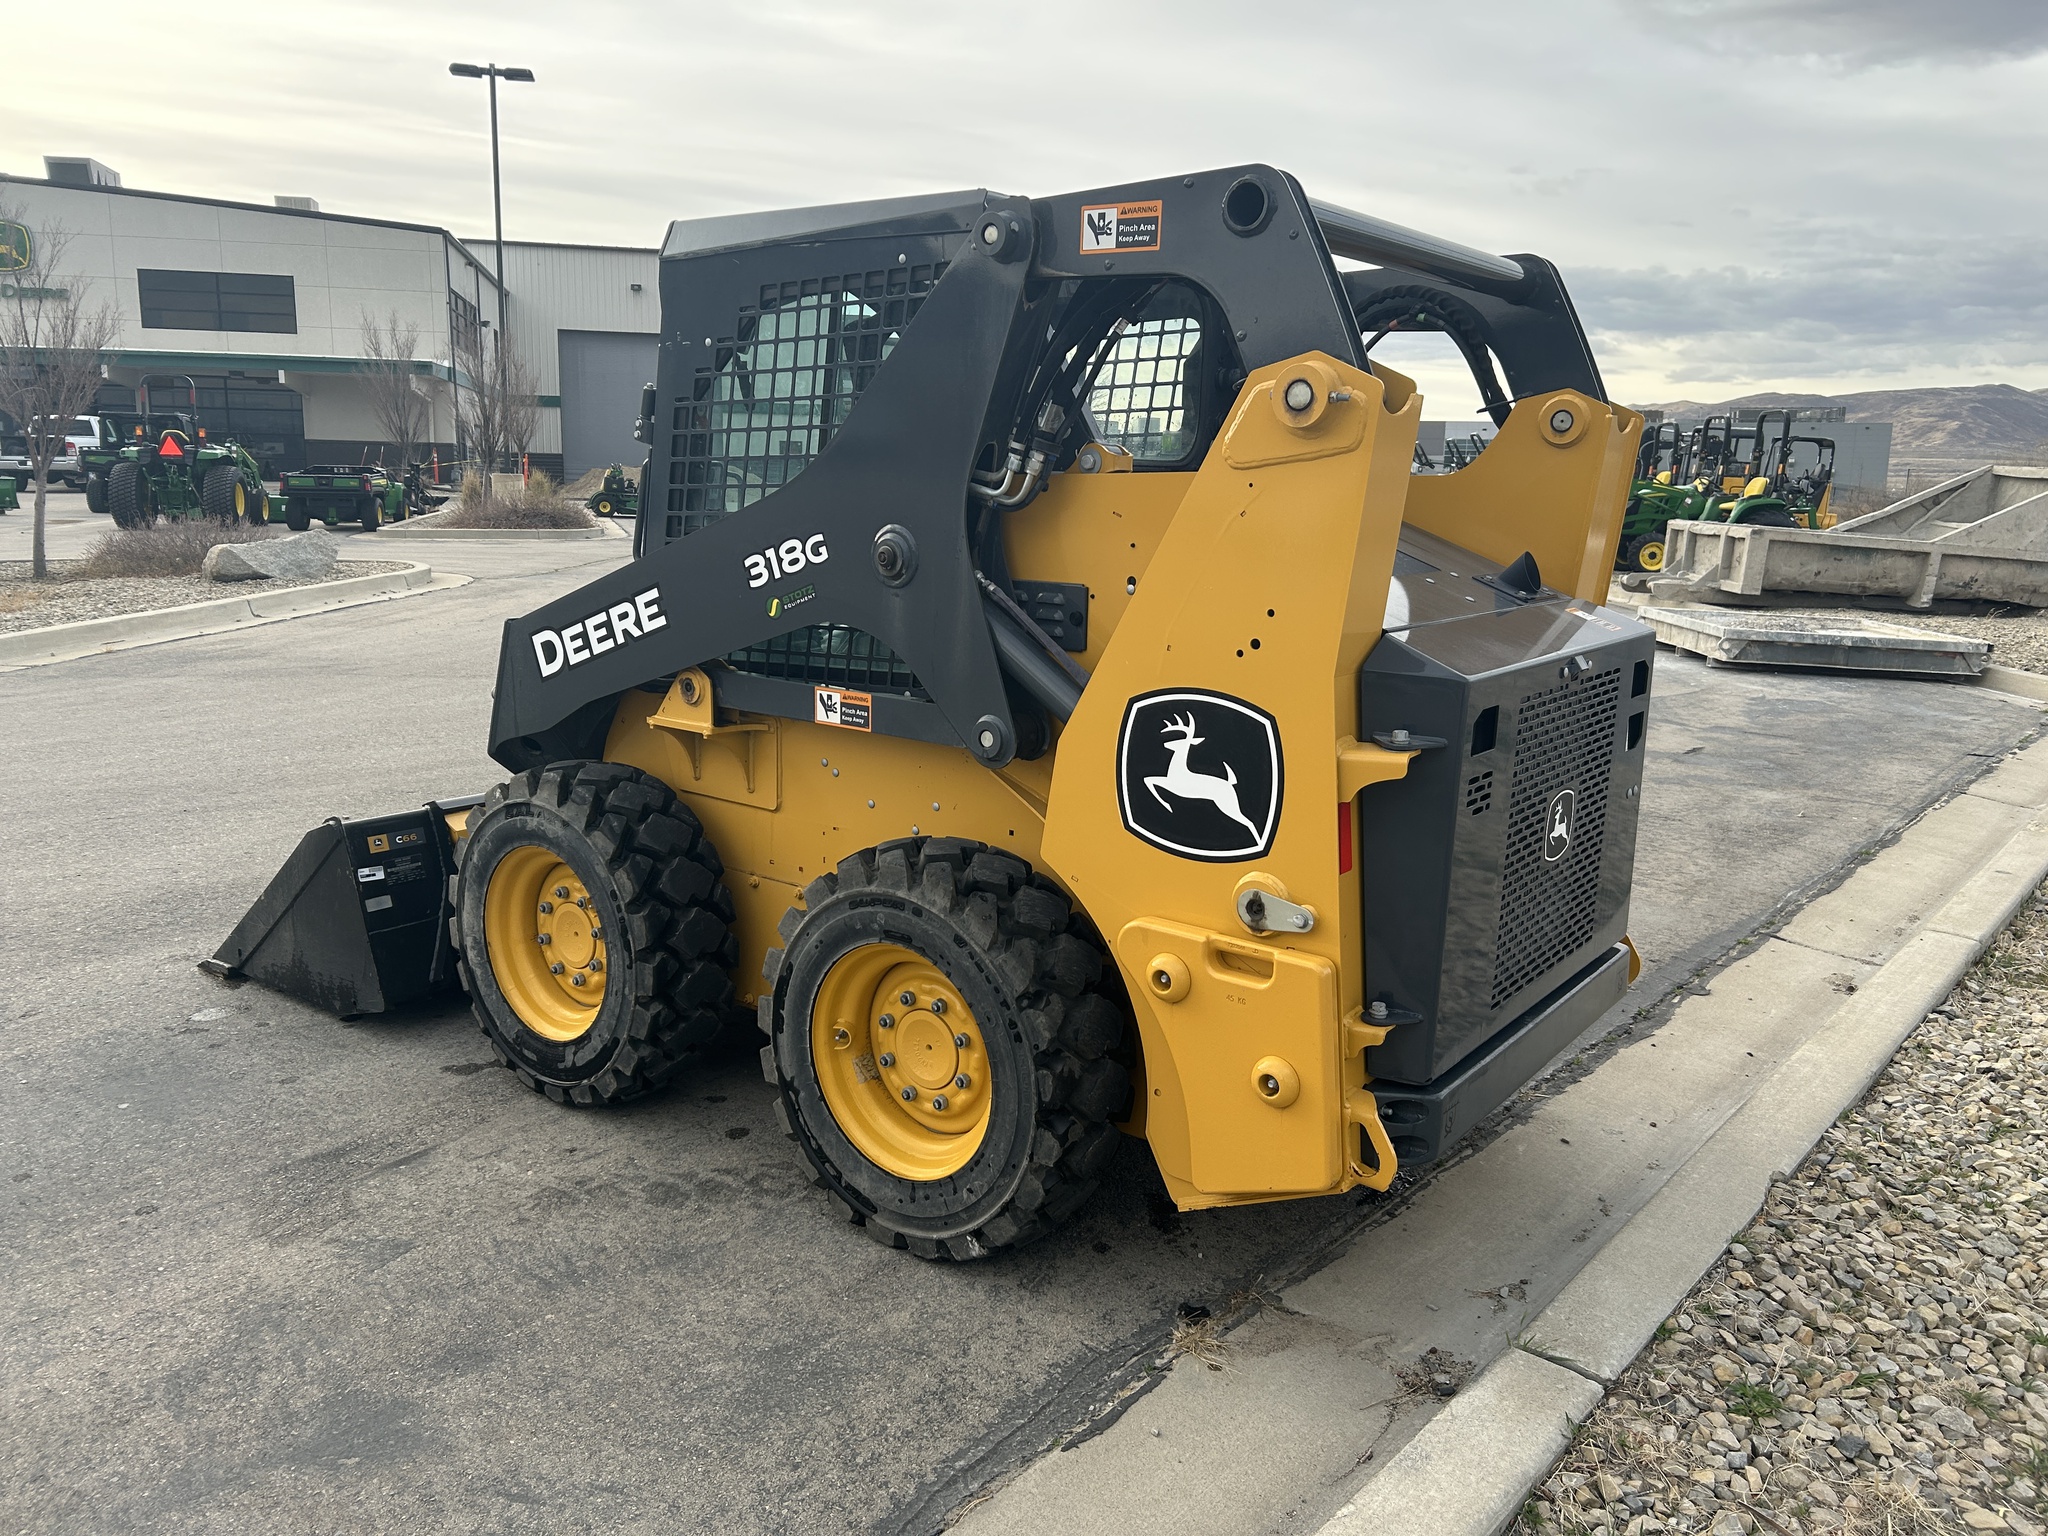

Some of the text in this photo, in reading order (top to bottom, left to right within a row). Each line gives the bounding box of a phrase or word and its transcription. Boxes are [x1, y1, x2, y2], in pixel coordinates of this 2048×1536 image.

[1127, 206, 1158, 214] WARNING
[1119, 223, 1156, 232] Pinch Area
[1134, 234, 1150, 242] Away
[744, 533, 829, 588] 318G
[782, 585, 814, 604] STOTZ
[784, 593, 816, 610] EQUIPMENT
[531, 587, 667, 678] DEERE
[841, 706, 868, 717] Pinch Area
[841, 714, 864, 724] Keep Away
[395, 833, 418, 843] C66
